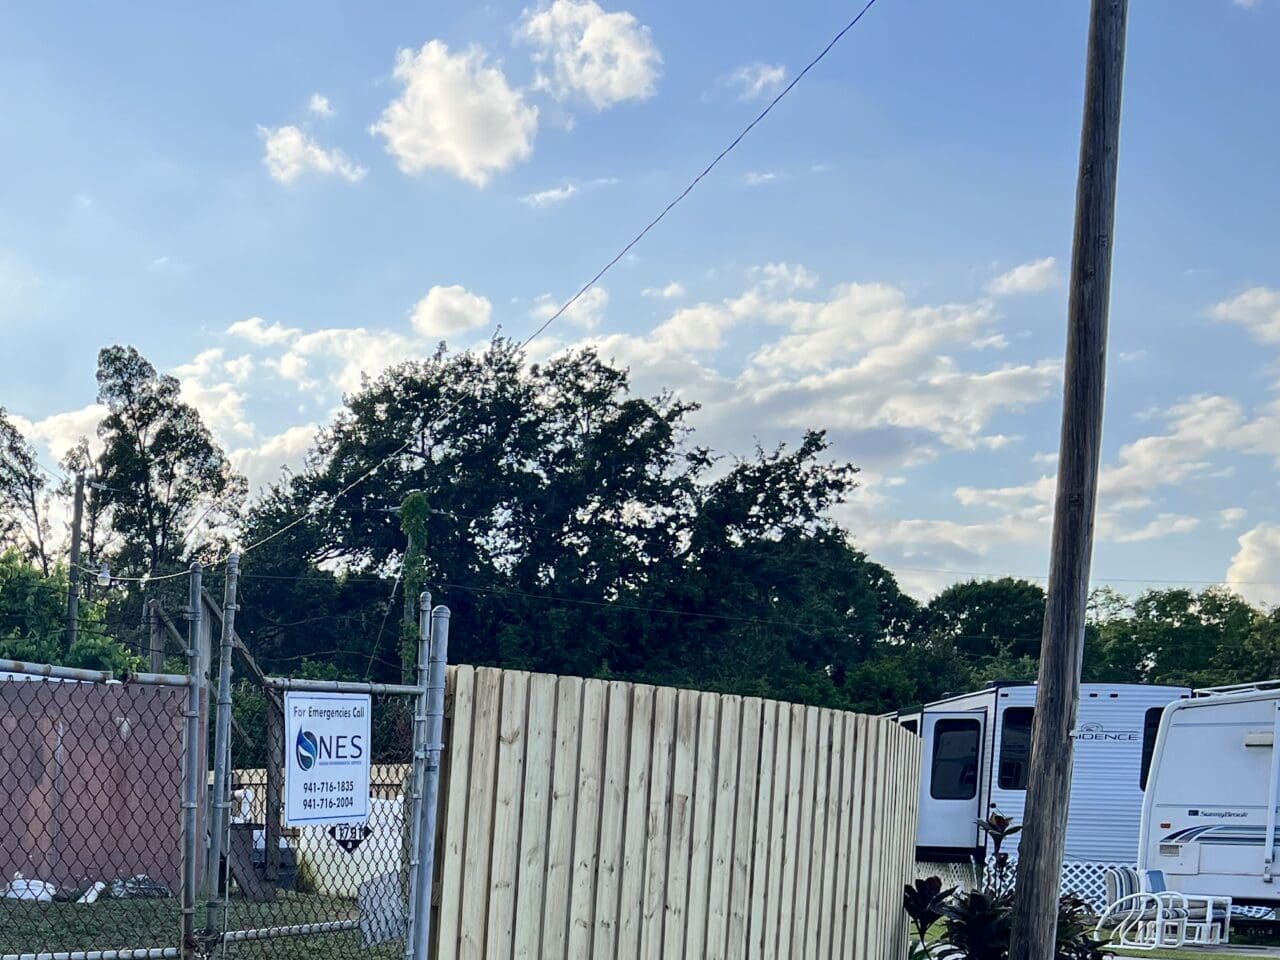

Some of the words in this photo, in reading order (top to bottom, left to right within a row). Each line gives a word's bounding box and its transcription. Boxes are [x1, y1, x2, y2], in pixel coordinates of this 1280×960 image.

[293, 706, 306, 717] For
[308, 706, 352, 720] Emergencies
[352, 706, 365, 718] Call
[1075, 733, 1139, 741] IDENCE
[319, 735, 362, 759] NES
[303, 780, 354, 793] 941-716-1835
[303, 796, 354, 810] 941-716-2004
